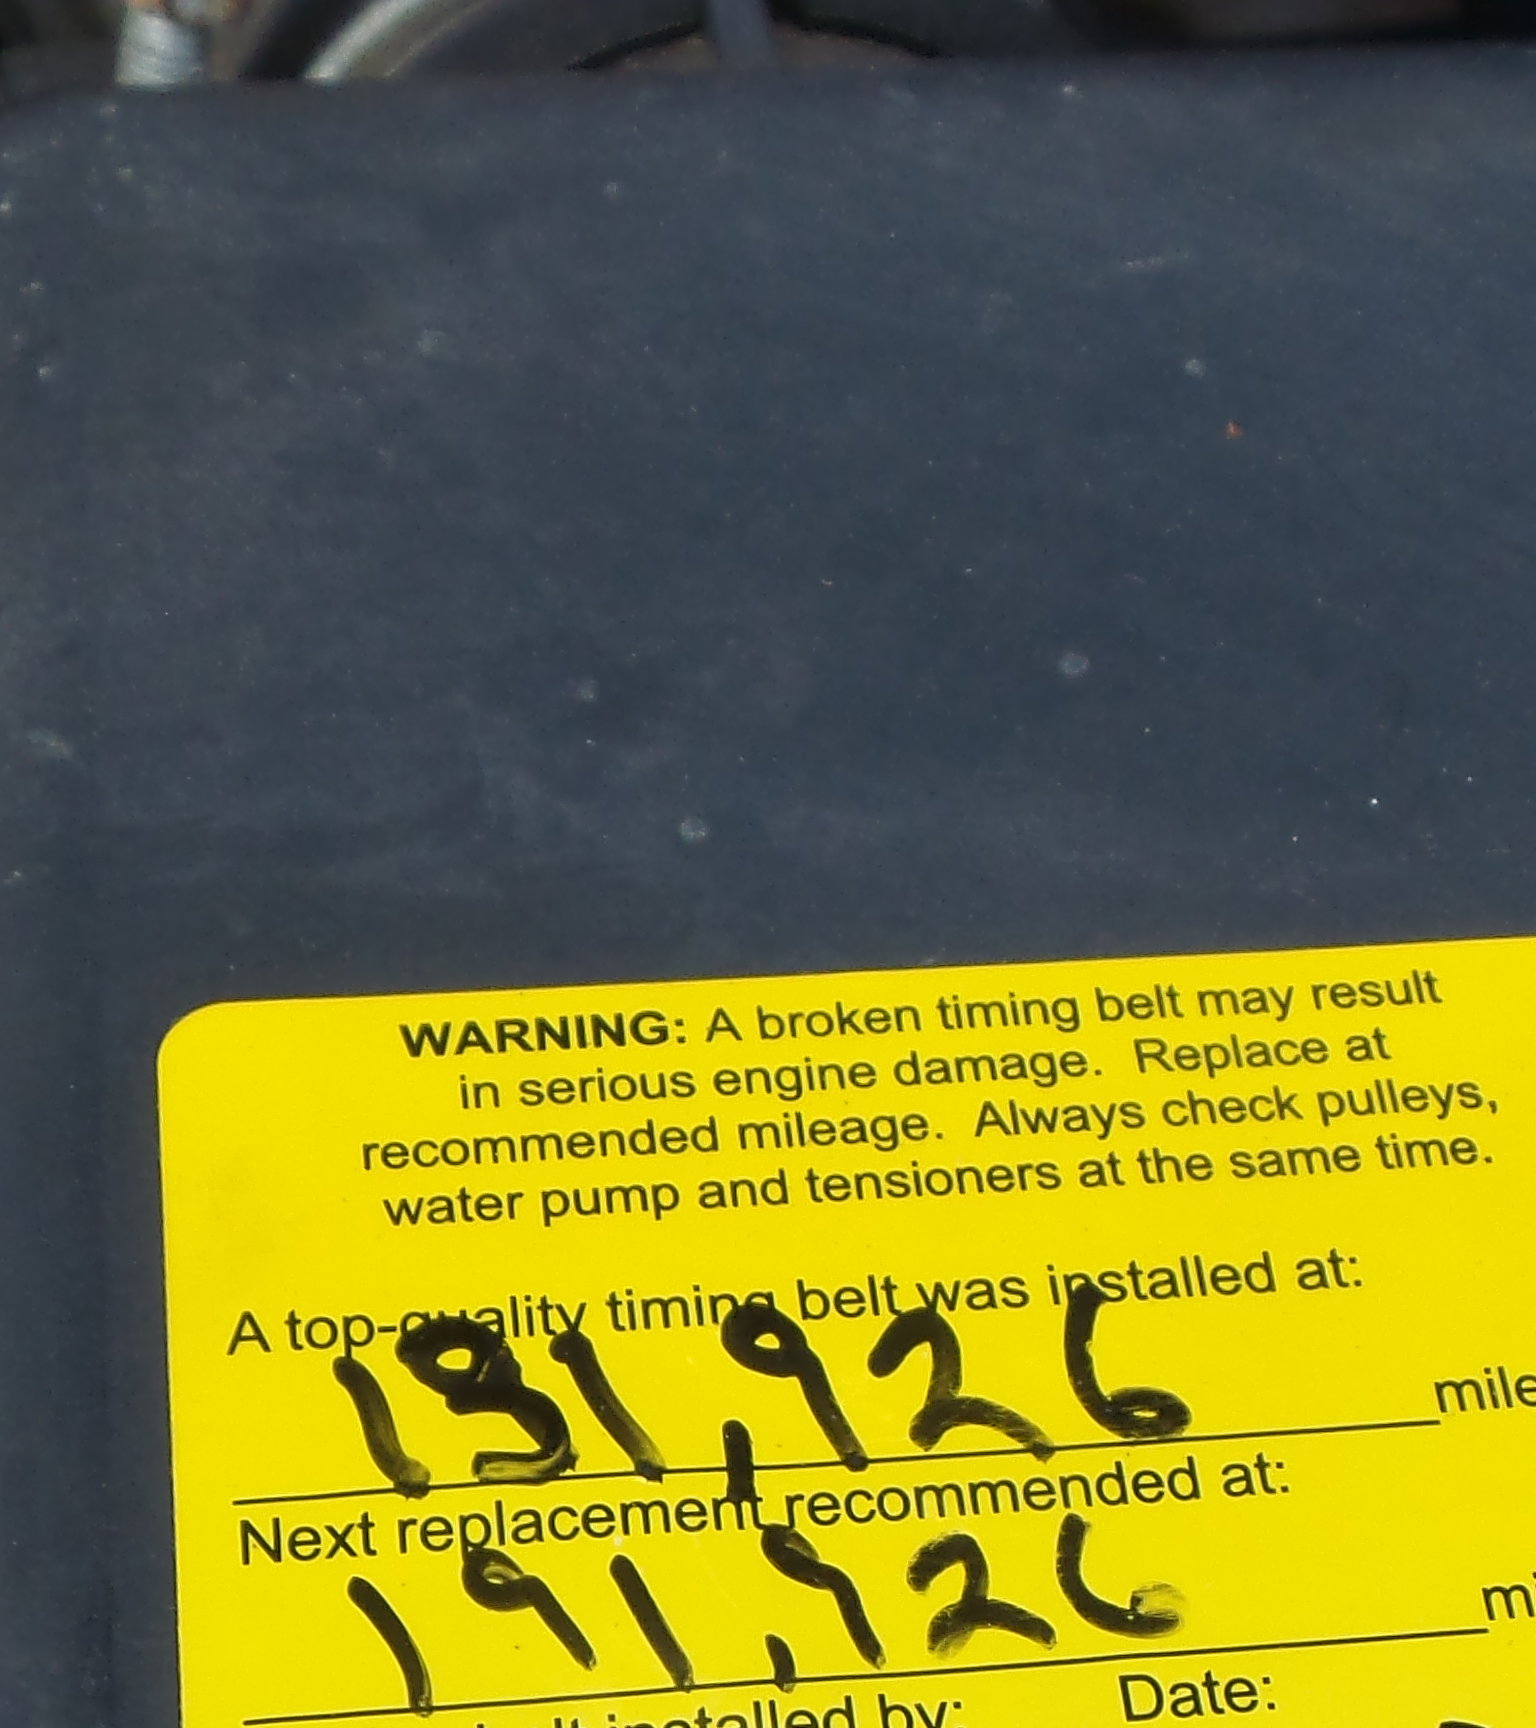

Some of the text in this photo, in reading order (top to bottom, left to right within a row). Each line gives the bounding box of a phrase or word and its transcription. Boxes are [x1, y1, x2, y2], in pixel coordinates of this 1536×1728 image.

[400, 969, 1443, 1057] WARNING: A broken timing belt may result
[459, 1026, 1390, 1109] in serious engine damage. Replace at
[362, 1078, 1498, 1170] recommended mileage. Always check pulleys,
[384, 1132, 1494, 1226] water pump and tensioners at the same time.
[226, 1310, 272, 1355] A
[796, 1274, 900, 1320] belt
[914, 1274, 1031, 1312] was
[1296, 1248, 1364, 1289] at:
[239, 1453, 1290, 1564] Next replacement recommended at:
[348, 1513, 1186, 1717] 191,926
[1119, 1671, 1277, 1722] Date:
